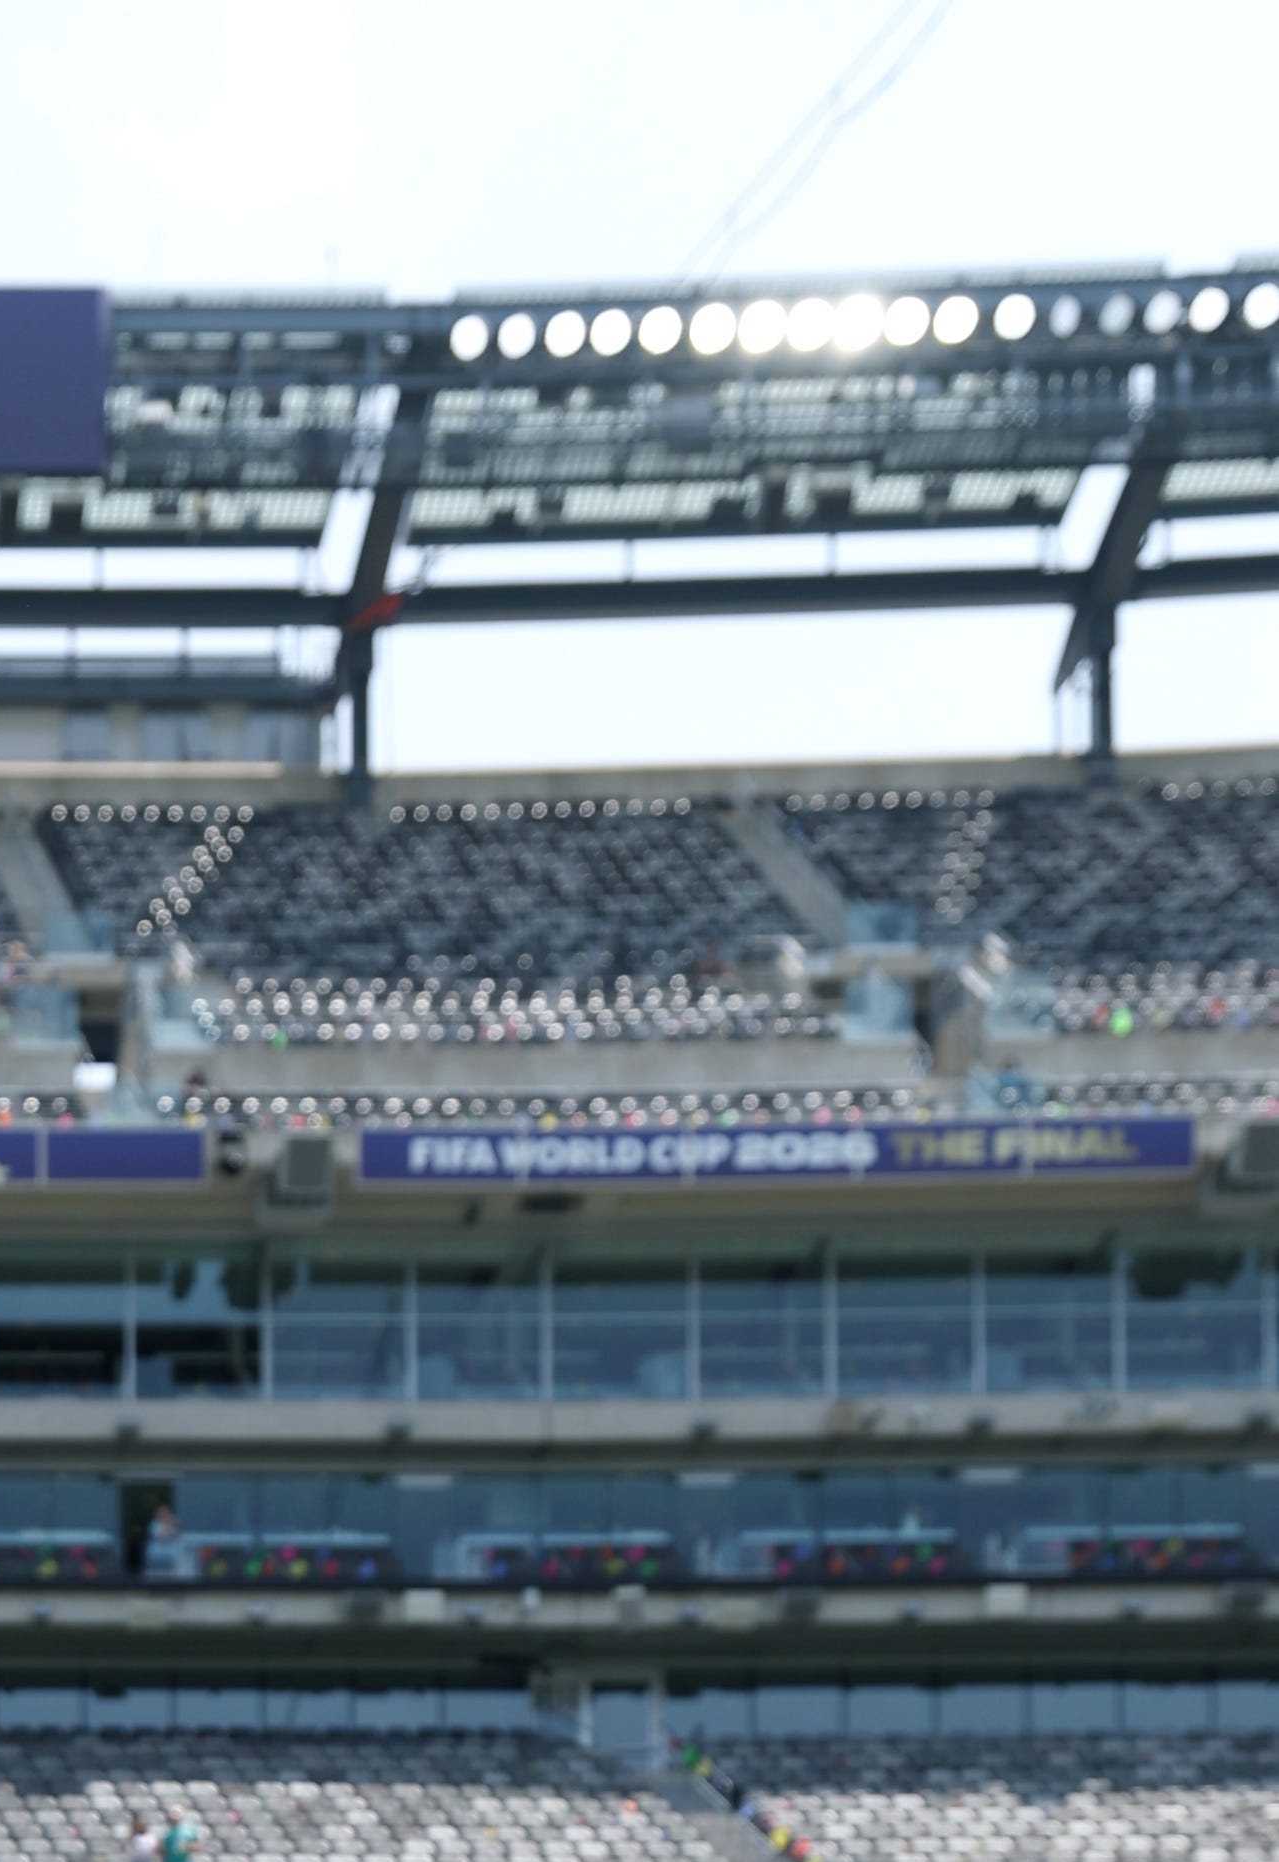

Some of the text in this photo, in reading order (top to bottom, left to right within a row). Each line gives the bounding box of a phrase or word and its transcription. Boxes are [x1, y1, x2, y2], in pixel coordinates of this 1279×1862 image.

[408, 1125, 1141, 1176] FIFA WORLD CUP 2026 THE FINAL
